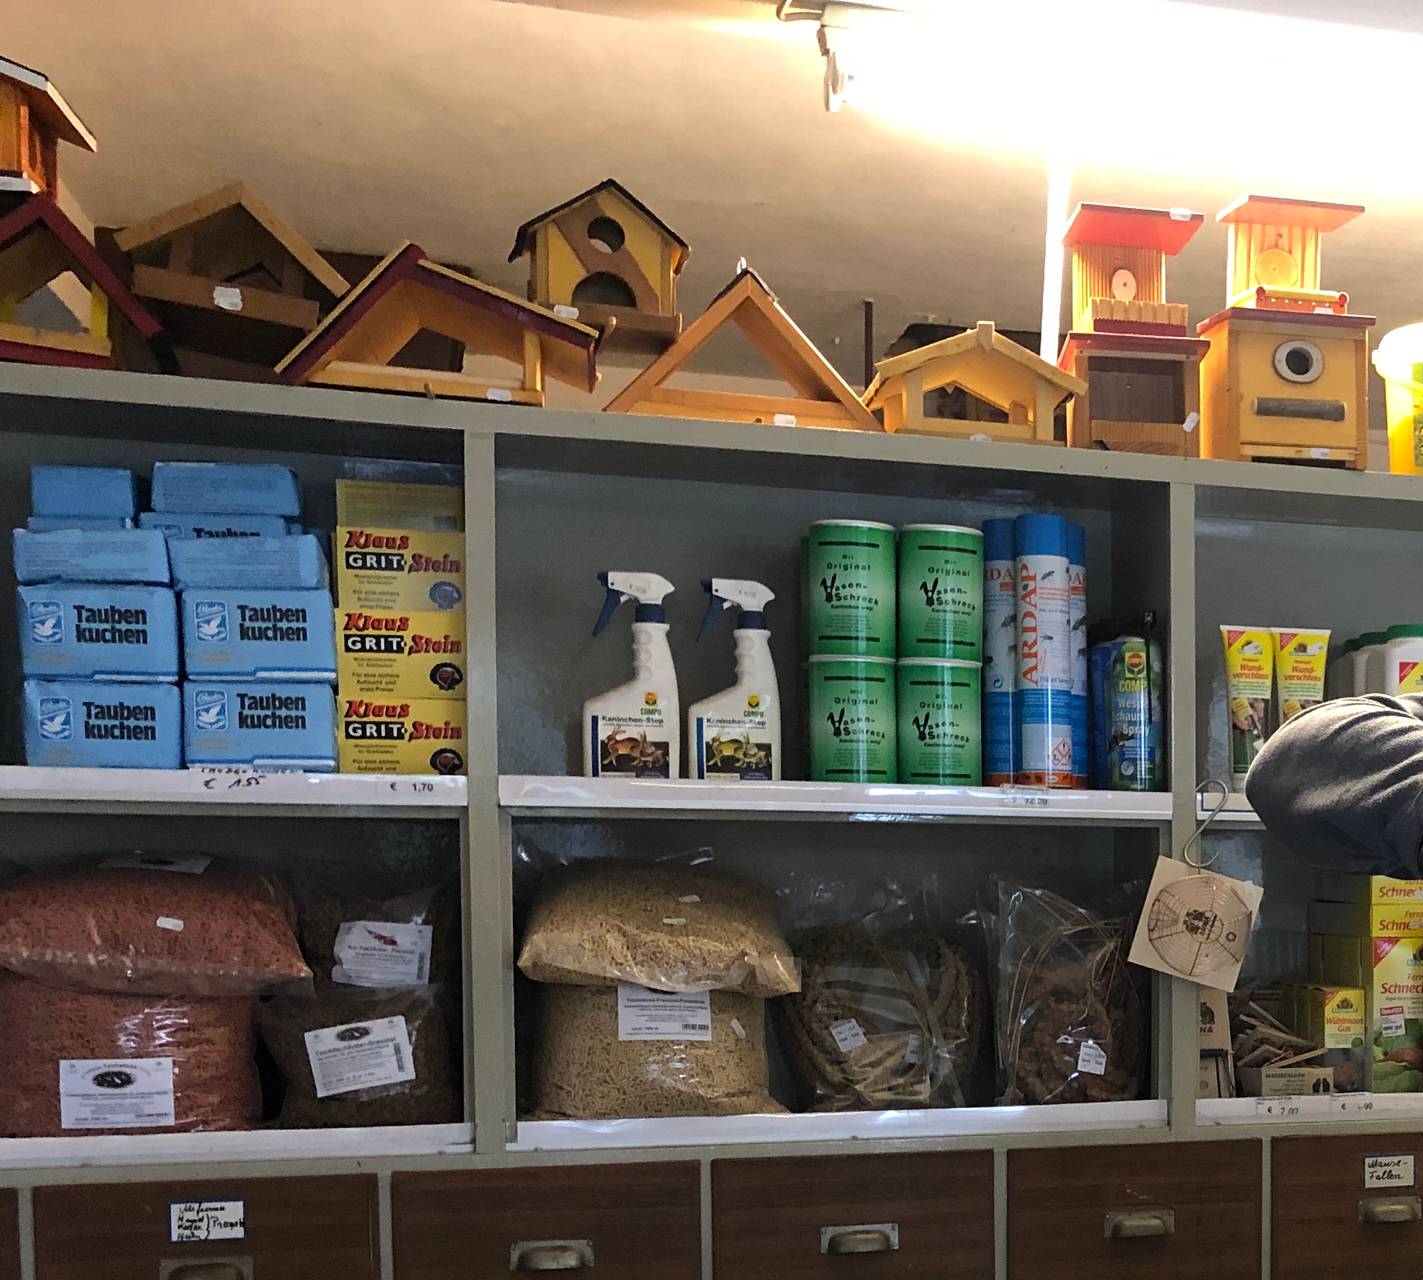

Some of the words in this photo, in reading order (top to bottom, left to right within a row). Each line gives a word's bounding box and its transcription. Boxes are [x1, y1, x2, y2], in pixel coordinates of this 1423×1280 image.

[344, 531, 410, 550] Klaus
[827, 562, 871, 571] Original
[928, 567, 970, 577] Original
[73, 605, 147, 624] Tauben
[237, 605, 307, 623] Tauben
[343, 613, 410, 632] Klaus
[239, 623, 307, 641] kuchen
[1021, 563, 1038, 686] ARDAP
[75, 624, 148, 644] kuchen
[1119, 680, 1148, 692] COMP
[237, 693, 306, 711] Tauben
[344, 700, 410, 718] Klaus
[834, 697, 878, 705] Original
[919, 701, 963, 710] Original
[82, 702, 156, 721] Tauben
[238, 711, 306, 729] kuchen
[602, 715, 664, 724] Kaninchen-Stop
[84, 721, 156, 740] kuchen
[390, 783, 397, 791] €
[412, 783, 434, 792] 1,70
